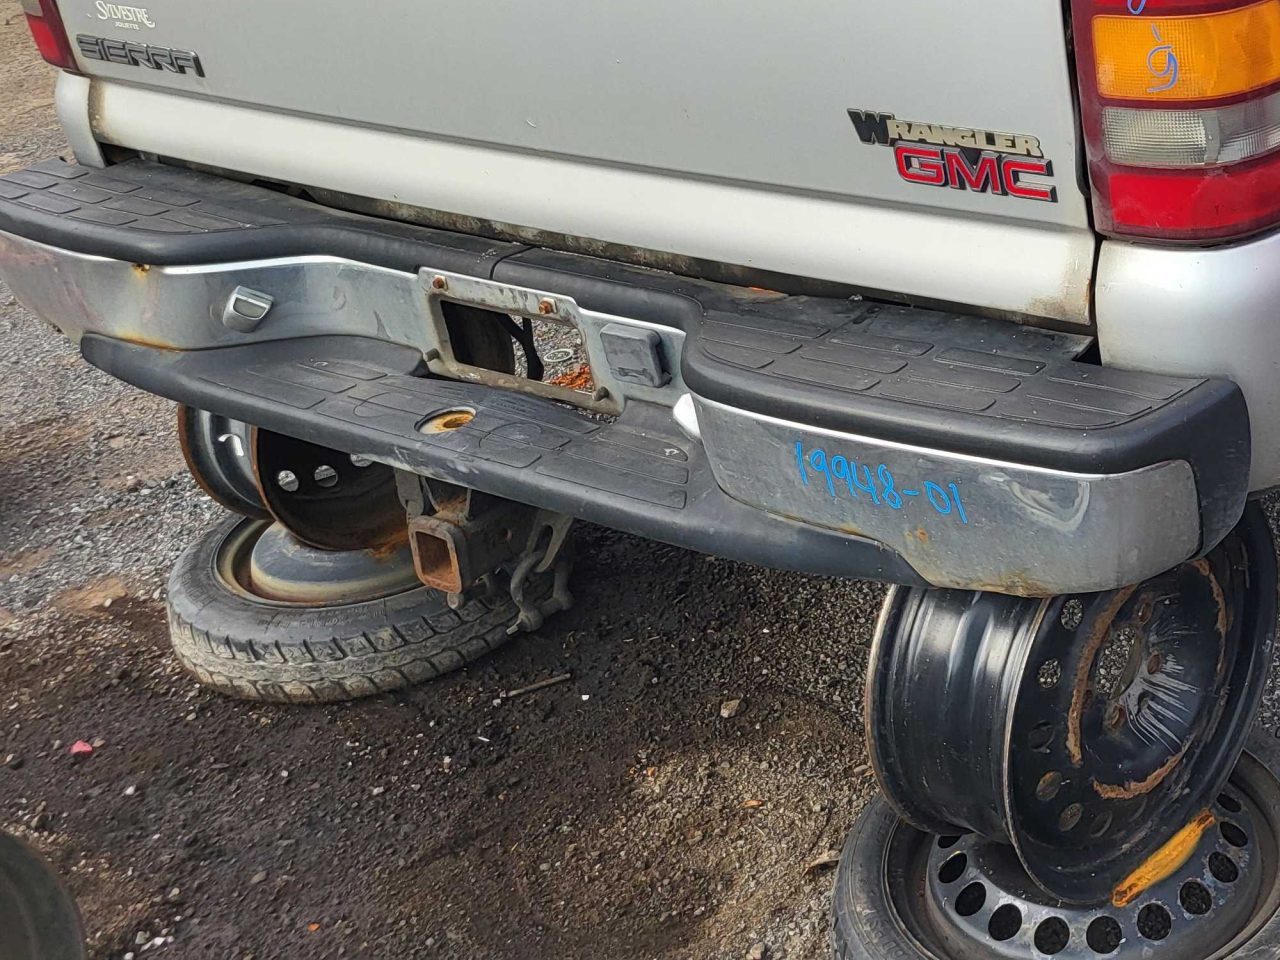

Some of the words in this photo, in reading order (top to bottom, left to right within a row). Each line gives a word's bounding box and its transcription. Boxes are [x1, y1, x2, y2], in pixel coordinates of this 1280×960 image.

[96, 0, 156, 28] SYLVESTRE
[76, 33, 206, 78] SIERRA
[847, 107, 1044, 158] WRANGLER
[893, 142, 1059, 203] GMC
[795, 440, 968, 524] 19948-01
